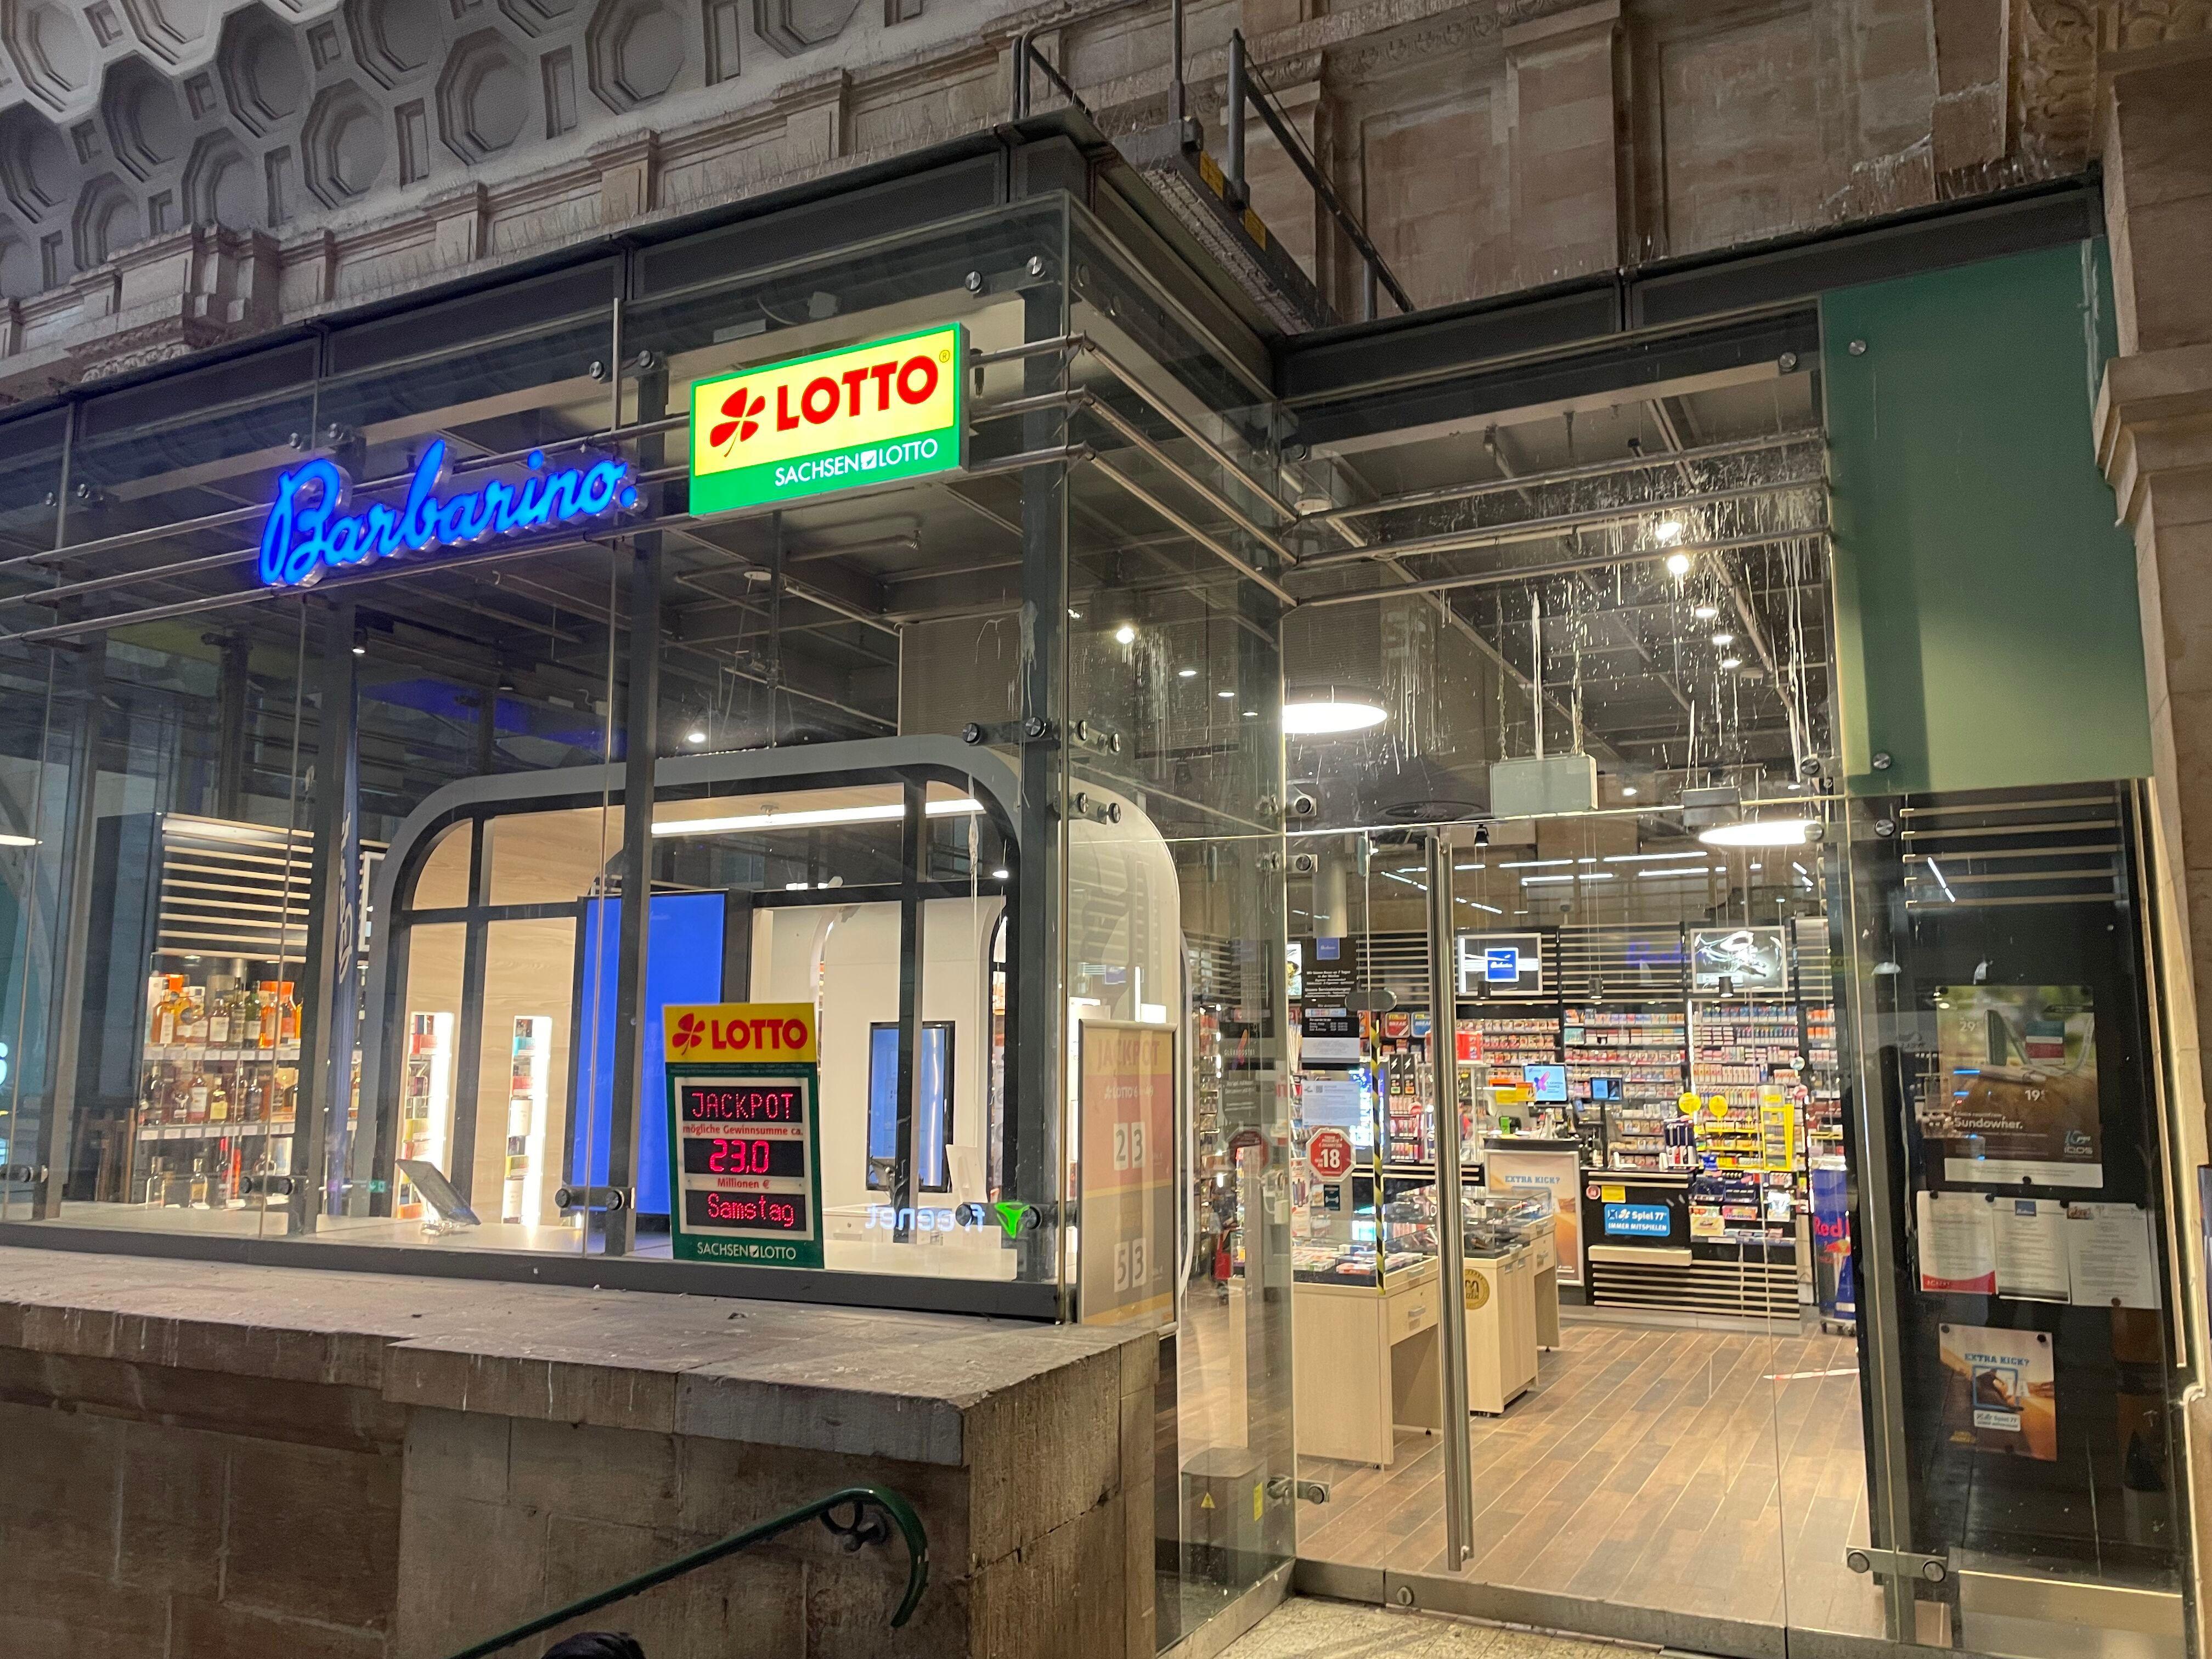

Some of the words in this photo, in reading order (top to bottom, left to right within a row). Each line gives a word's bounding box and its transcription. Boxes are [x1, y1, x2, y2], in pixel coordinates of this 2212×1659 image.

[777, 356, 939, 432] LOTTO
[775, 453, 859, 486] SACHSEN
[879, 438, 938, 467] LOTTO
[712, 1018, 808, 1050] LOTTO
[692, 1092, 794, 1119] JACKPOT
[682, 1124, 720, 1136] mögliche
[723, 1125, 788, 1135] Gewinnsumme
[709, 1138, 769, 1173] 23,0
[1321, 1148, 1340, 1169] 18
[717, 1177, 759, 1188] Millionen
[1534, 1176, 1560, 1184] KICK?
[708, 1193, 794, 1227] Samstag
[1632, 1211, 1654, 1221] Spiel
[1655, 1212, 1664, 1221] 77
[1813, 1216, 1843, 1238] Red
[697, 1242, 748, 1256] SACHSEN
[760, 1245, 796, 1260] LOTTO
[1964, 1352, 1997, 1363] EXTRA
[2000, 1356, 2030, 1366] KICK?
